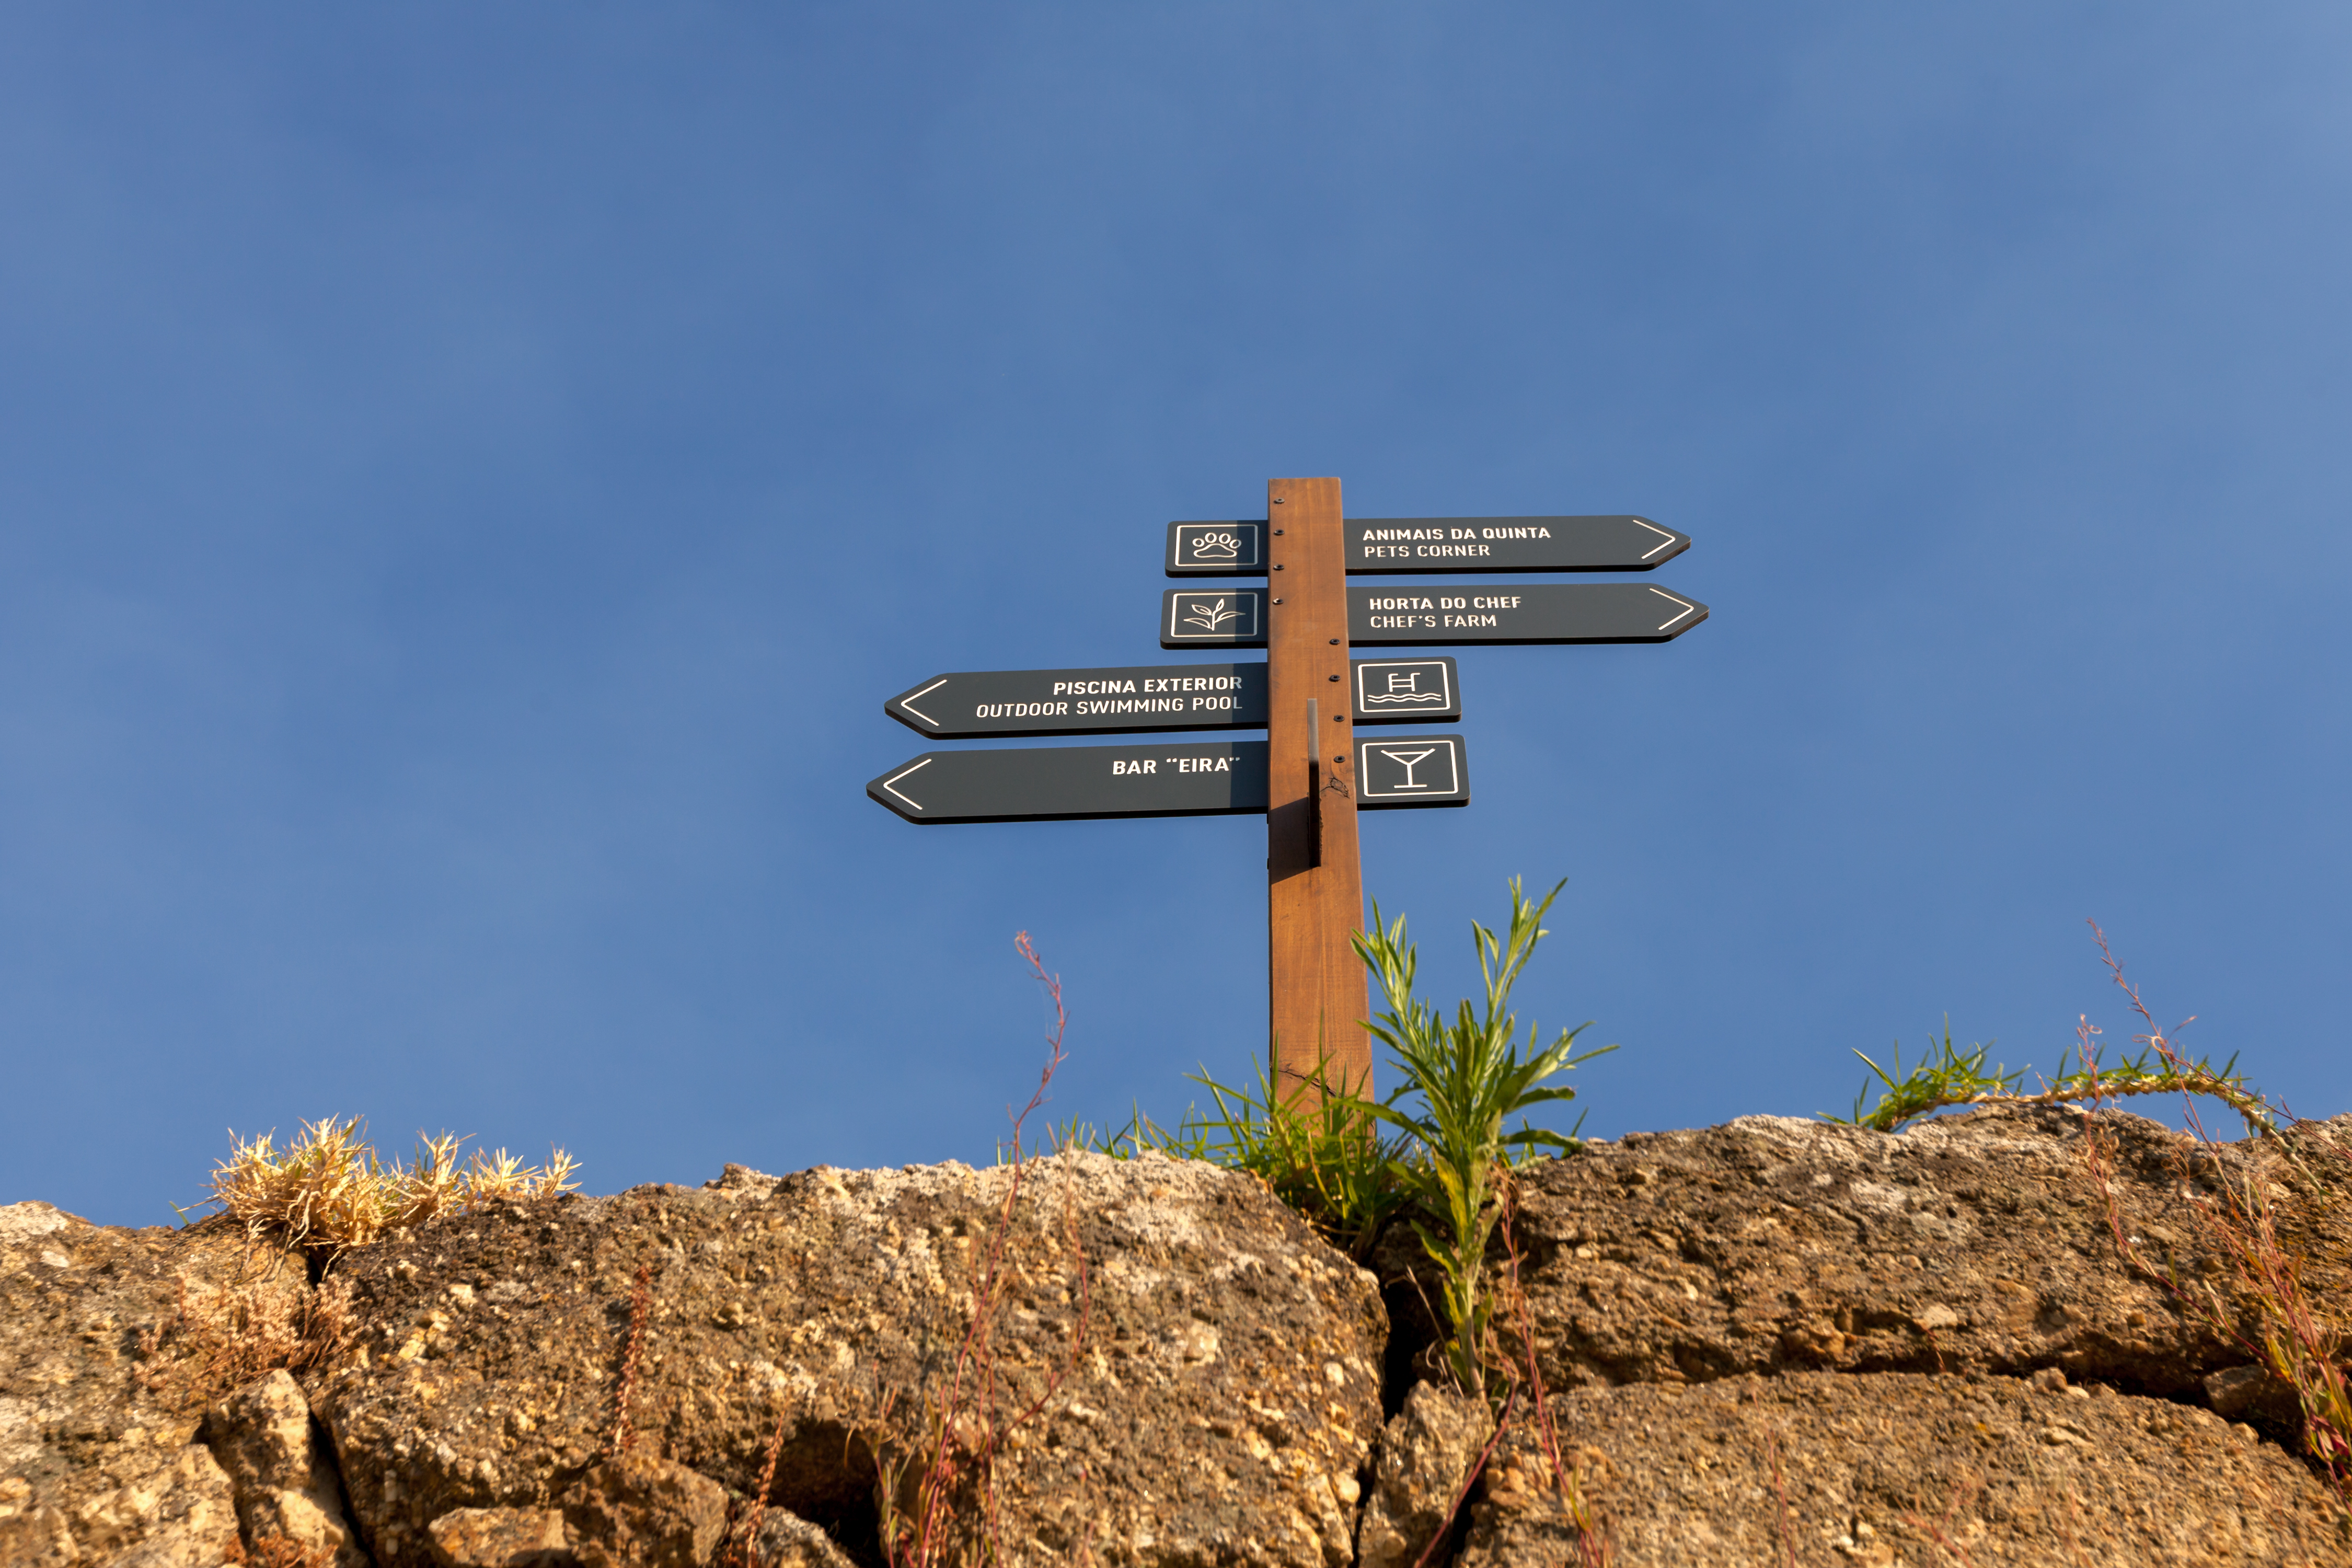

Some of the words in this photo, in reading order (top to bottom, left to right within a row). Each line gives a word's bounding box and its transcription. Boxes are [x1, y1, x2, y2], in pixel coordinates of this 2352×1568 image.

[1363, 528, 1444, 540] ANIMAIS
[1451, 528, 1477, 539] DA
[1483, 527, 1551, 539] QUINTA
[1365, 546, 1410, 558] PETS
[1417, 545, 1490, 557] CORNER
[1370, 597, 1434, 610] HORTA
[1440, 597, 1466, 609] DO
[1474, 596, 1521, 608] CHEF
[1444, 615, 1496, 627] FARM
[1054, 680, 1136, 695] PISCINA
[1144, 677, 1241, 692] EXTERIOR
[976, 702, 1068, 718] OUTDOOR
[1077, 698, 1183, 714] SWIMMING
[1193, 697, 1242, 710] POOL
[1113, 760, 1156, 775] BAR
